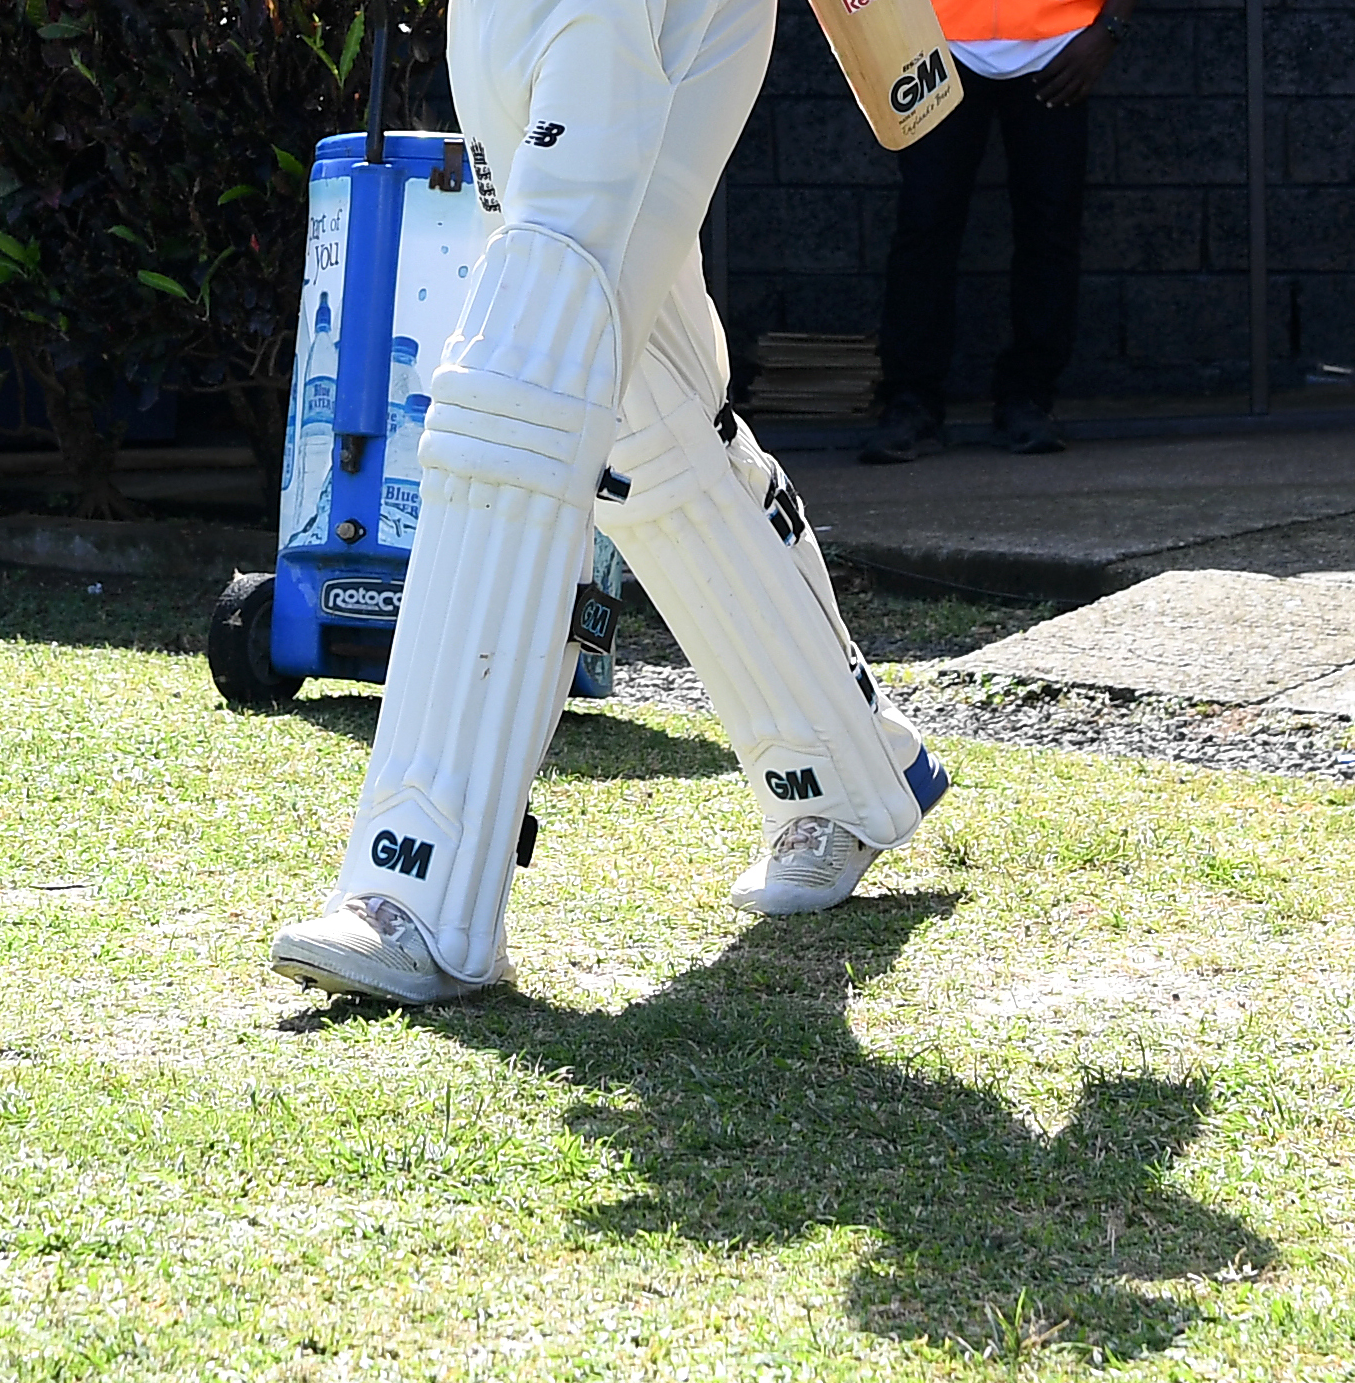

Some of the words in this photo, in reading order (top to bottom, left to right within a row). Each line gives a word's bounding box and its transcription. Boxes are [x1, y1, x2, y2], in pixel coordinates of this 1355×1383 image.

[890, 47, 948, 114] GM
[312, 242, 340, 286] you
[385, 485, 420, 503] Blue
[764, 766, 824, 802] GM
[371, 829, 434, 882] GM
